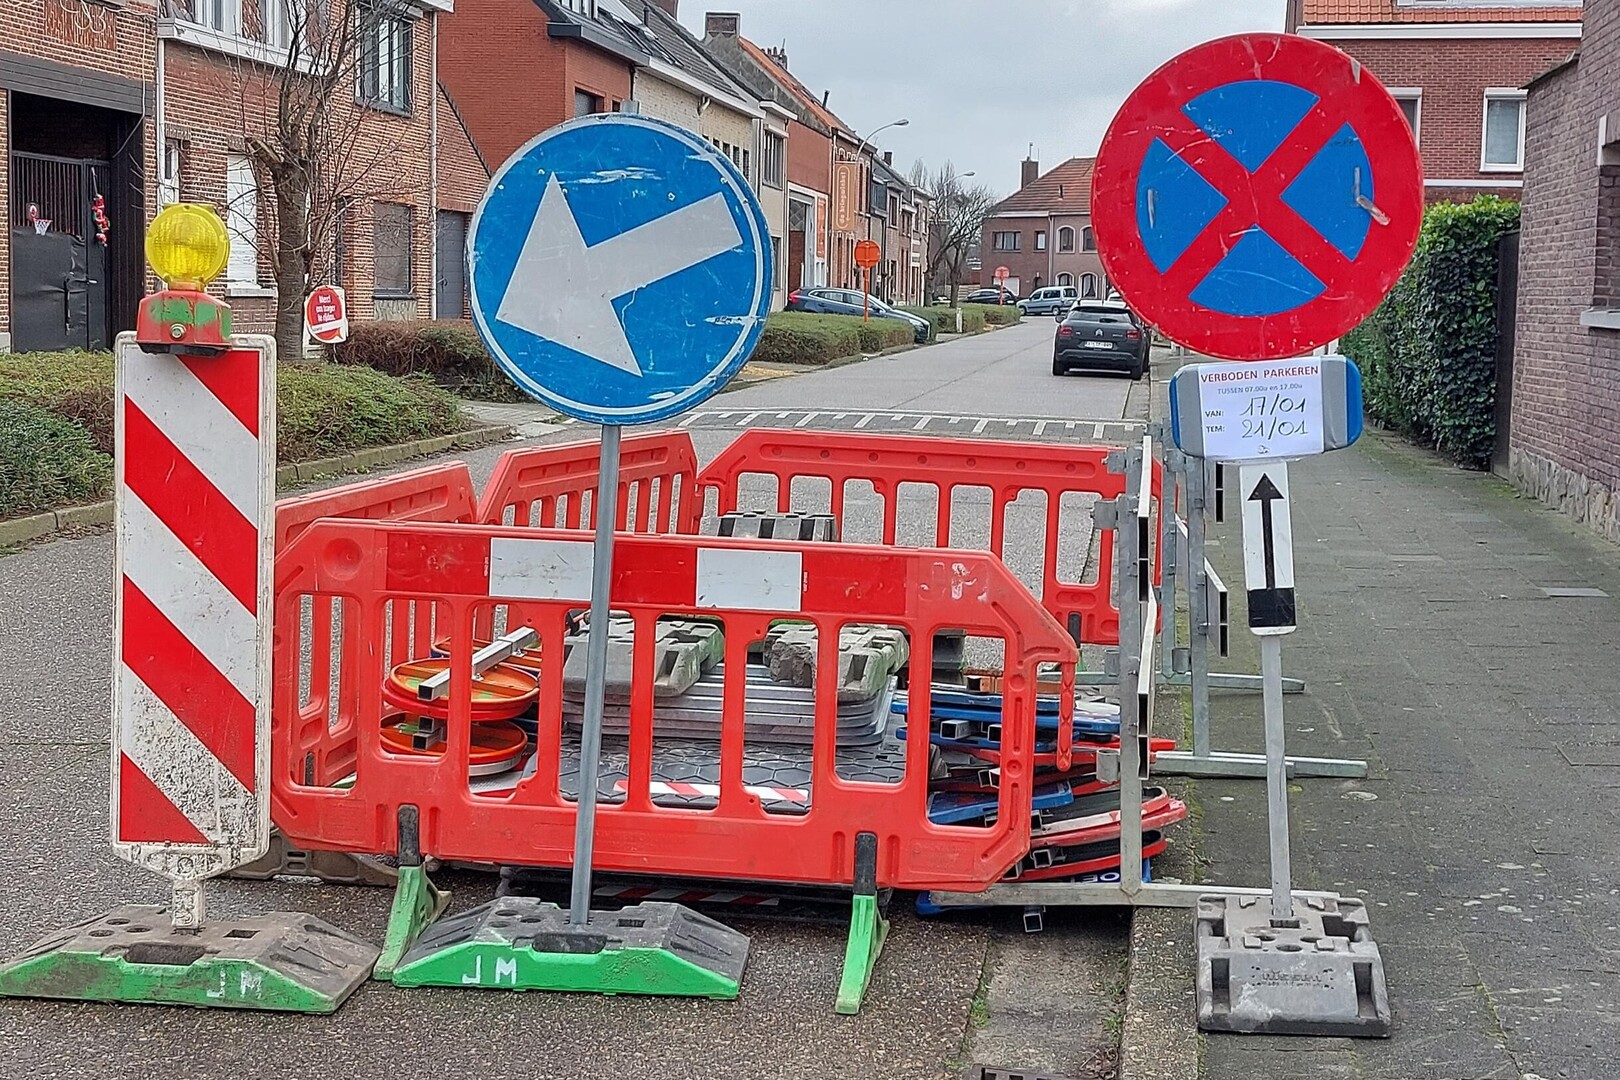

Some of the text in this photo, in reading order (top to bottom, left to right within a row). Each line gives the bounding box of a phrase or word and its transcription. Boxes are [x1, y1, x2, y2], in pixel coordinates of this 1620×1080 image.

[1200, 365, 1319, 383] VERBODEN PARKEREN
[1217, 387, 1243, 395] TUSSEN
[1240, 393, 1306, 416] 17/01
[1206, 416, 1308, 440] TEM: 21/01
